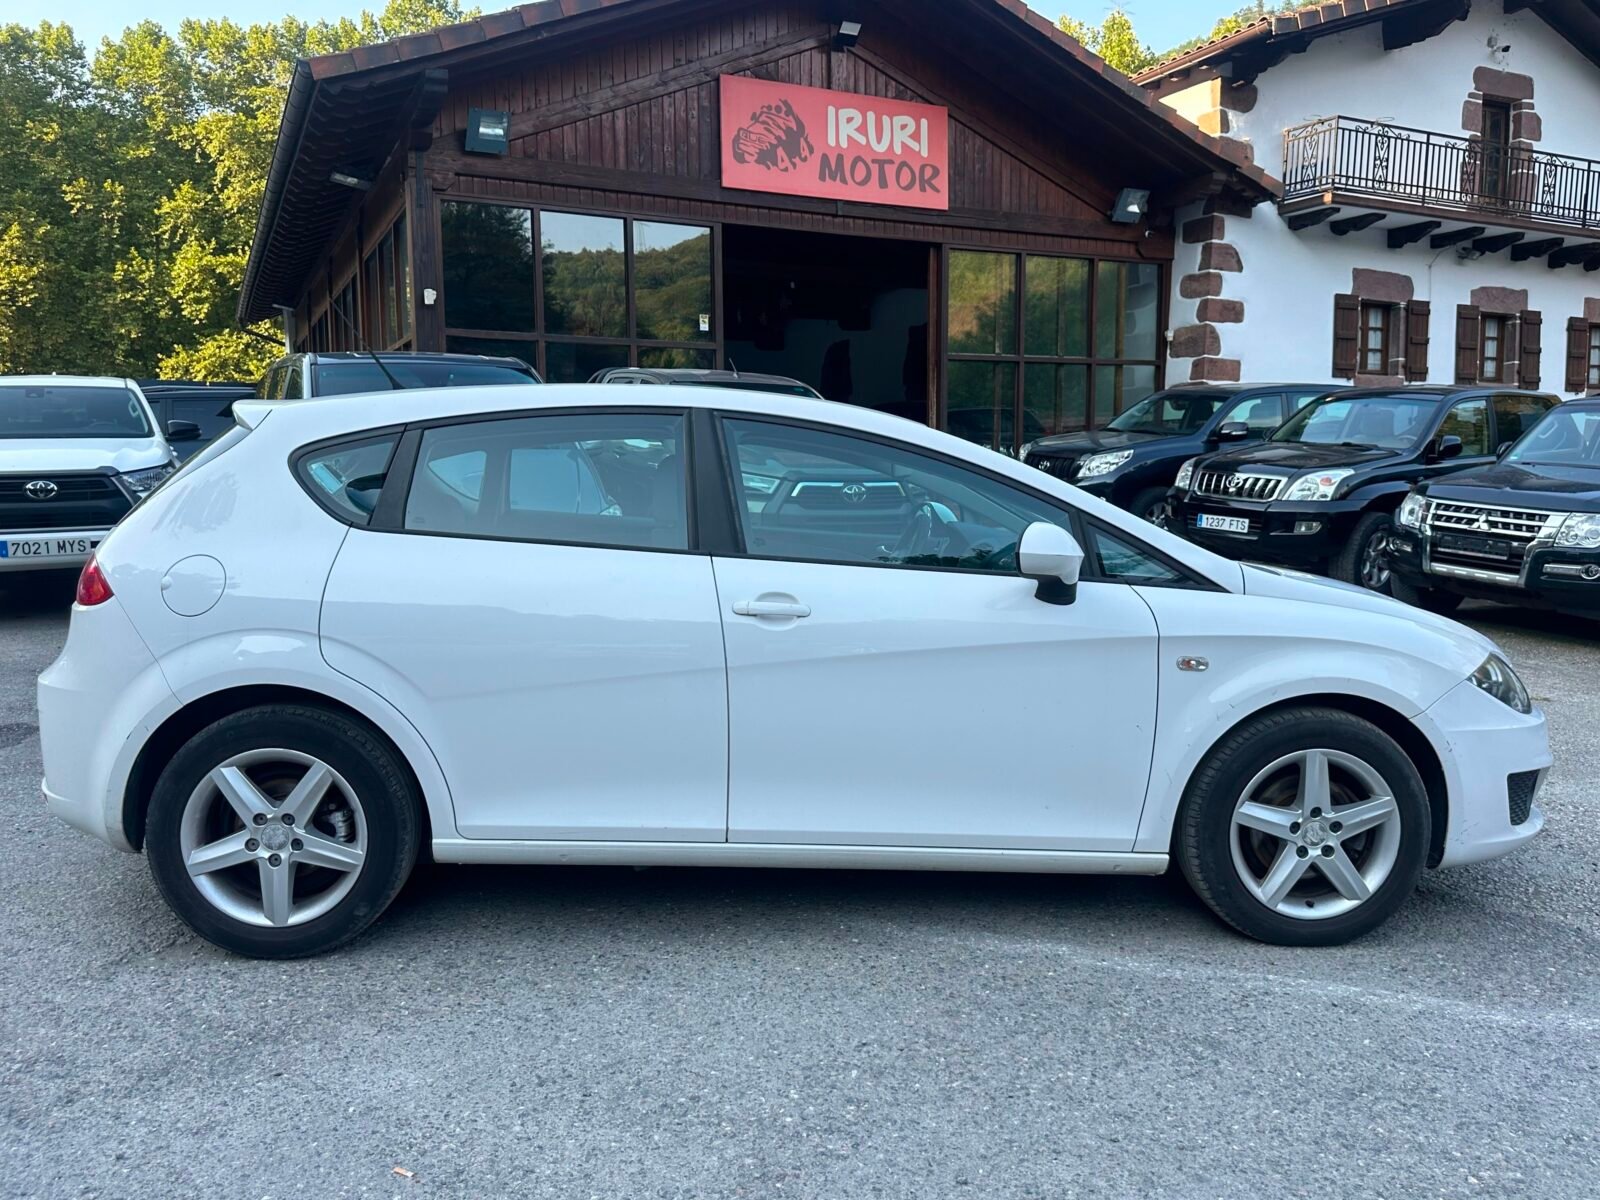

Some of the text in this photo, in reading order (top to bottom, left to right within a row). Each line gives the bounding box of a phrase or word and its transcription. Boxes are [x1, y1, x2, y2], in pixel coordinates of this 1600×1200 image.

[827, 105, 929, 158] IRURI
[818, 153, 941, 194] MOTOR
[1205, 516, 1246, 531] 1237 FTS
[11, 539, 87, 556] 7021 MYS
